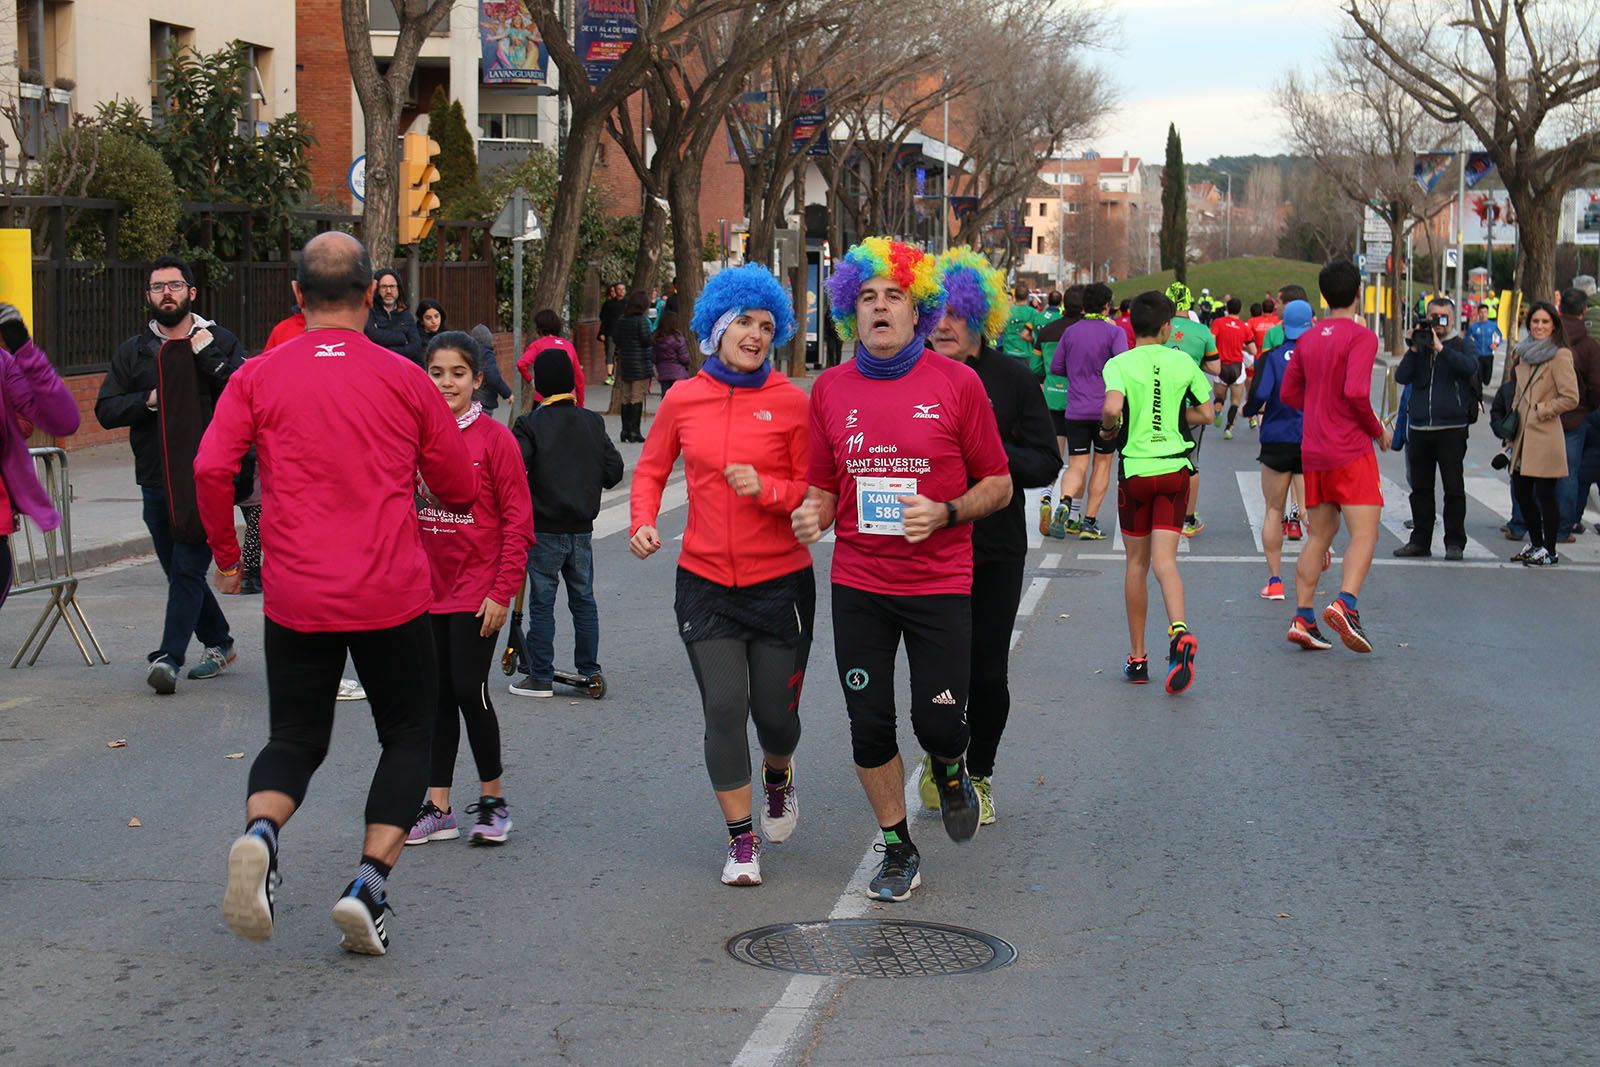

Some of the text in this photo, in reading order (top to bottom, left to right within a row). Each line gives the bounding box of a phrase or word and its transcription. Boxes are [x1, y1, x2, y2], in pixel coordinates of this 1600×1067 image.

[1358, 255, 1366, 271] P
[845, 432, 898, 454] 19 edició
[845, 458, 929, 468] SANT SILVESTRE
[909, 466, 931, 474] Cugat
[875, 506, 901, 519] 586
[454, 517, 475, 525] Cugat
[932, 697, 956, 705] adidas
